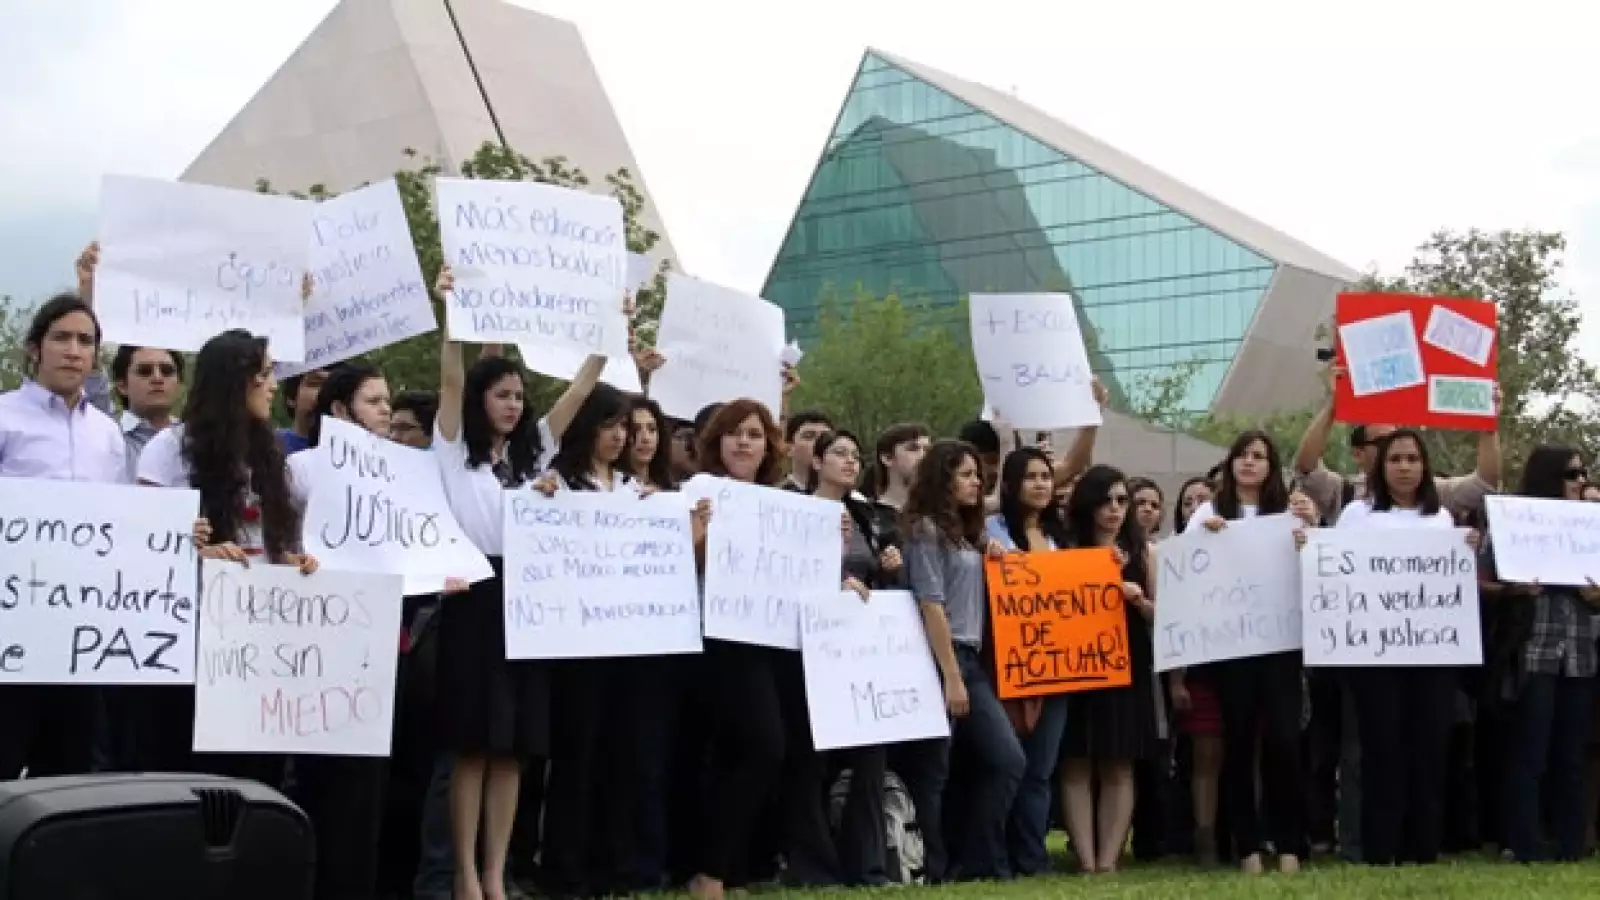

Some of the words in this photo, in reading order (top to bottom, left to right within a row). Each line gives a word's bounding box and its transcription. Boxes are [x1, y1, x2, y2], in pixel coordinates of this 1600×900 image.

[456, 197, 524, 232] Más
[0, 516, 114, 557] omos
[1001, 557, 1042, 588] ES
[1368, 548, 1473, 578] momento
[995, 581, 1122, 620] MOMENTO
[1309, 582, 1341, 613] de
[1345, 582, 1369, 614] la
[1377, 581, 1463, 613] verdad
[69, 625, 180, 676] PAZ
[1020, 620, 1056, 649] DE
[1320, 625, 1338, 655] y
[1345, 617, 1369, 648] la
[1373, 617, 1460, 658] justicia
[259, 685, 384, 739] MIEDO
